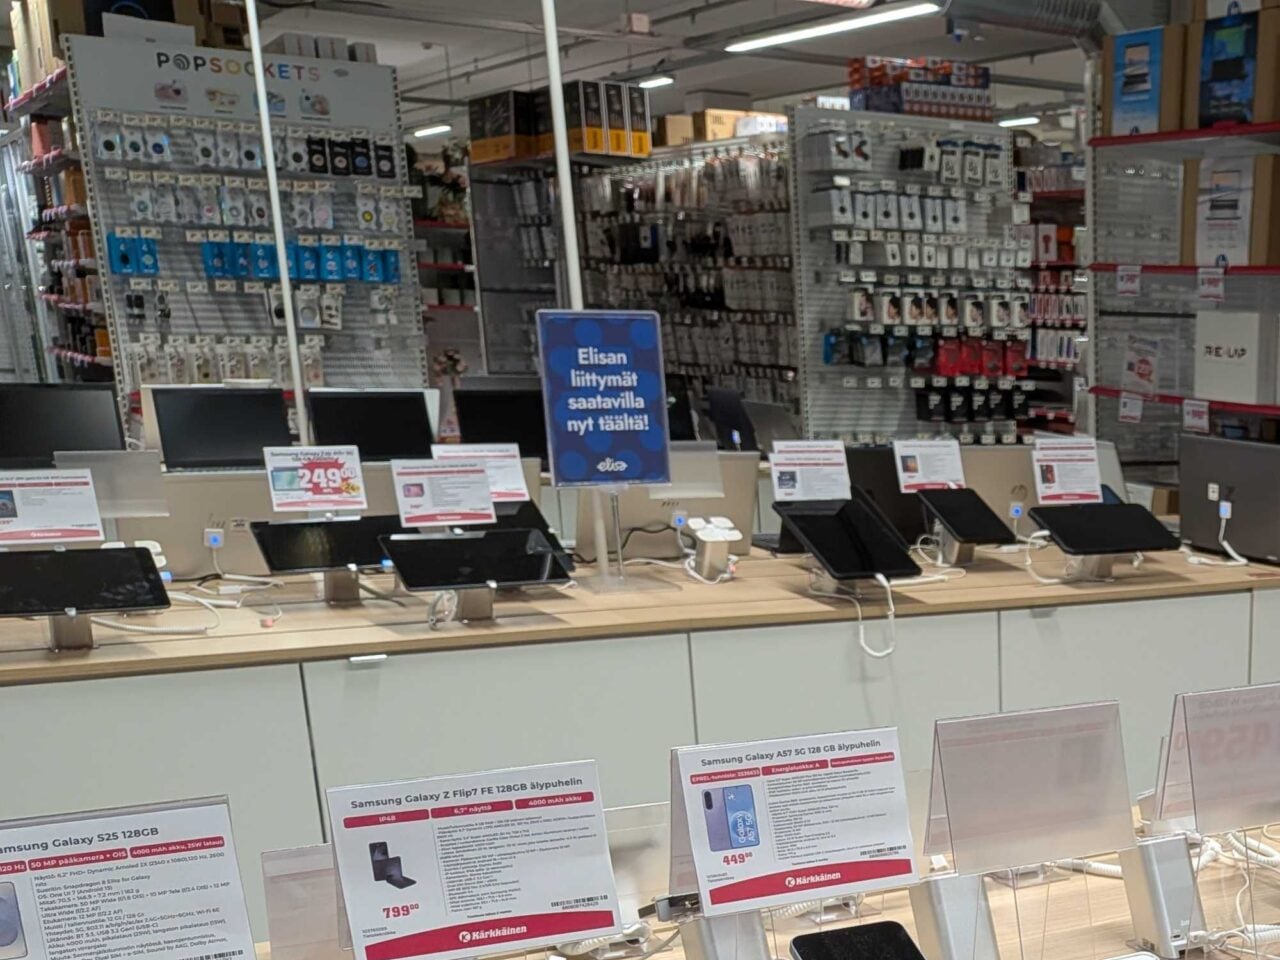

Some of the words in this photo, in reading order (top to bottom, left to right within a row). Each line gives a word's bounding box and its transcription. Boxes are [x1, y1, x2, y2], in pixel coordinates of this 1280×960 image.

[578, 346, 628, 365] Elisan
[570, 369, 638, 391] liittymät
[567, 392, 646, 410] saatavilla
[567, 418, 594, 436] nyt
[598, 413, 650, 432] täältä!
[700, 755, 743, 766] Samsung
[744, 752, 774, 761] Galaxy
[775, 749, 792, 757] A57
[794, 747, 806, 756] 5G
[807, 745, 821, 754] 128
[823, 744, 835, 752] GB
[837, 739, 880, 752] älypuhelin
[350, 797, 402, 809] Samsung
[404, 793, 440, 803] Galaxy
[443, 791, 450, 799] Z
[452, 788, 477, 798] Flip7
[480, 786, 493, 795] FE
[496, 783, 527, 793] 128GB
[529, 777, 582, 790] älypuhelin
[51, 836, 93, 847] Galaxy
[96, 831, 118, 841] S25
[121, 826, 159, 838] 128GB
[57, 854, 104, 865] pääkamera
[795, 872, 841, 885] Kärkkäinen
[471, 925, 527, 940] Kärkkäinen
